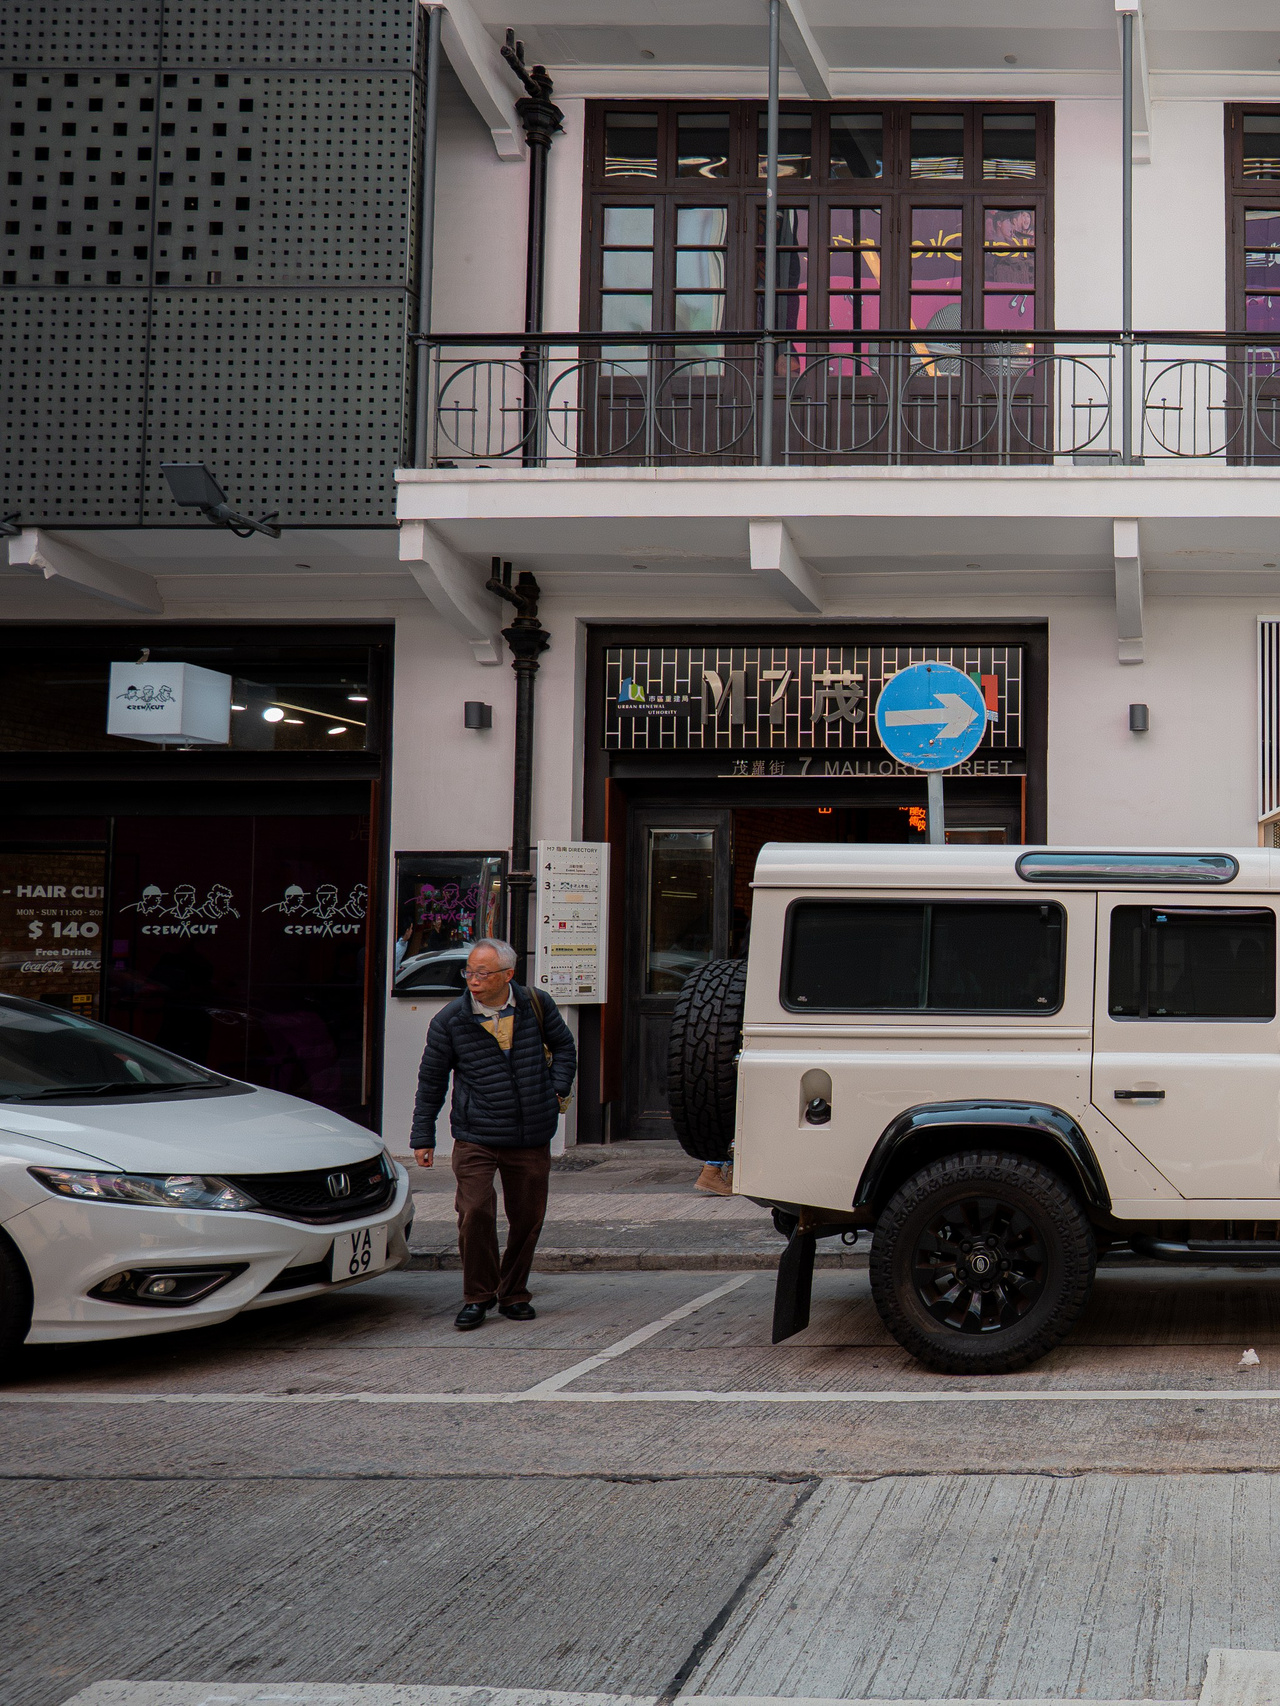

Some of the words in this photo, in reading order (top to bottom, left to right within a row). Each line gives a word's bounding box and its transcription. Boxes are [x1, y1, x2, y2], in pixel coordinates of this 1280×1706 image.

[648, 695, 689, 703] 市區重建局
[731, 759, 786, 776] 茂蘿街
[798, 756, 813, 776] 7
[544, 862, 552, 871] 4
[544, 882, 551, 890] 3
[17, 885, 66, 898] HAIR
[71, 886, 104, 898] CUT
[544, 915, 550, 924] 2
[28, 920, 44, 940] $
[52, 922, 100, 938] 140
[62, 948, 92, 956] Drink
[544, 946, 548, 954] 1
[540, 974, 548, 984] G
[351, 1228, 372, 1254] VA
[348, 1250, 371, 1276] 69
